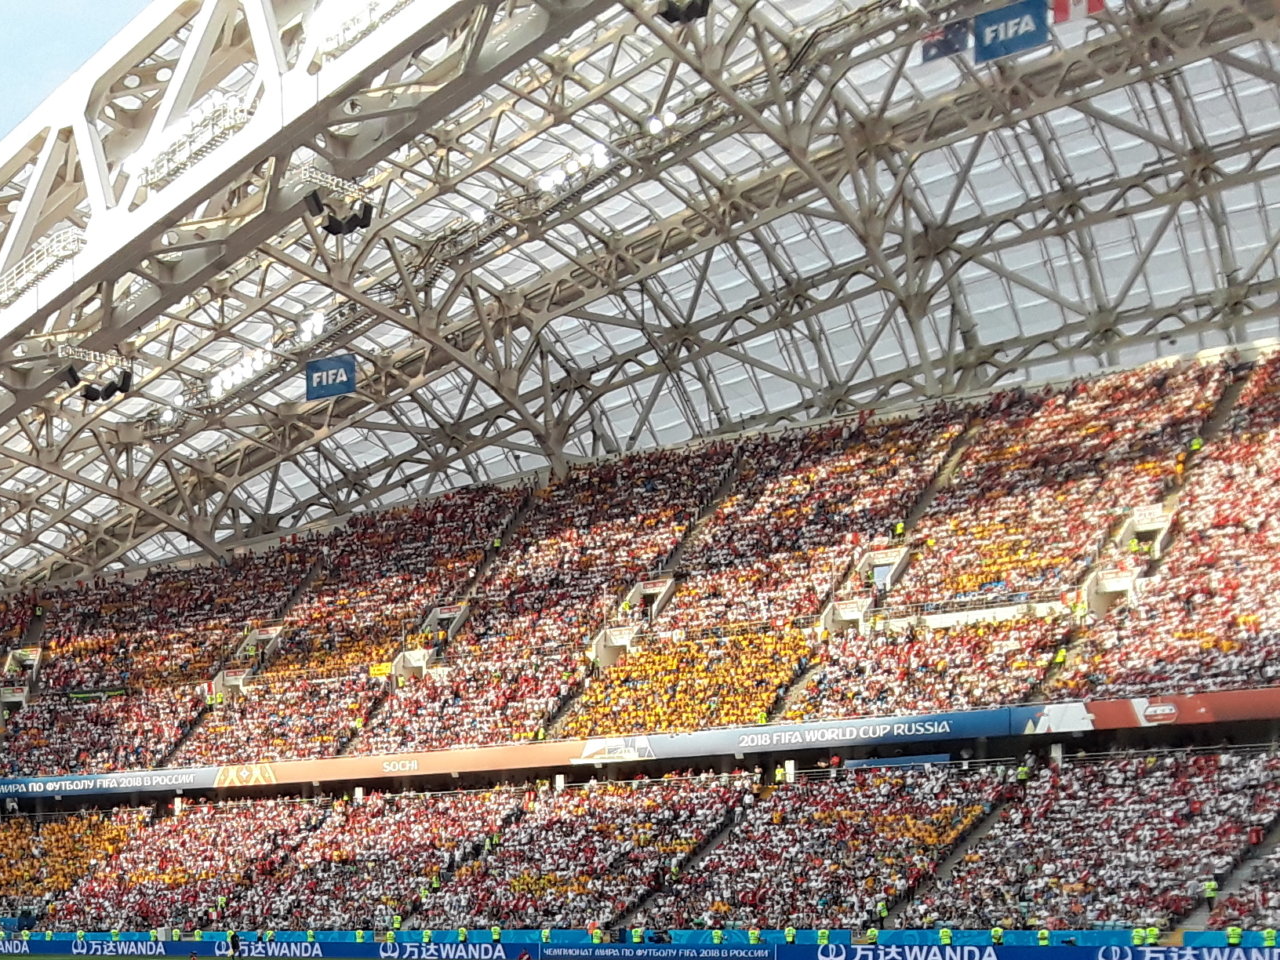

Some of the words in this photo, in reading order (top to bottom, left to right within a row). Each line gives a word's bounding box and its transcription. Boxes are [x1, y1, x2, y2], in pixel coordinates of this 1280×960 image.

[983, 14, 1036, 47] FIFA
[312, 368, 348, 388] FIFA
[738, 733, 771, 747] 2018
[773, 731, 803, 745] FIFA
[805, 728, 857, 743] WORLD
[860, 726, 891, 740] CUP
[893, 722, 951, 737] RUSSIA
[382, 760, 418, 772] SOCHI
[28, 782, 43, 792] ПО
[46, 780, 94, 791] ФУТБОЛУ
[97, 778, 118, 788] FIFA
[119, 776, 142, 787] 2018
[143, 776, 151, 785] В
[153, 773, 195, 785] РОССИИ
[543, 948, 593, 956] ЧЕМПИОНАТ
[621, 949, 634, 957] ПО
[635, 949, 674, 958] ФУТБОЛУ
[678, 949, 697, 957] FIFA
[699, 949, 720, 957] 2018
[730, 949, 769, 957] РОССИИ
